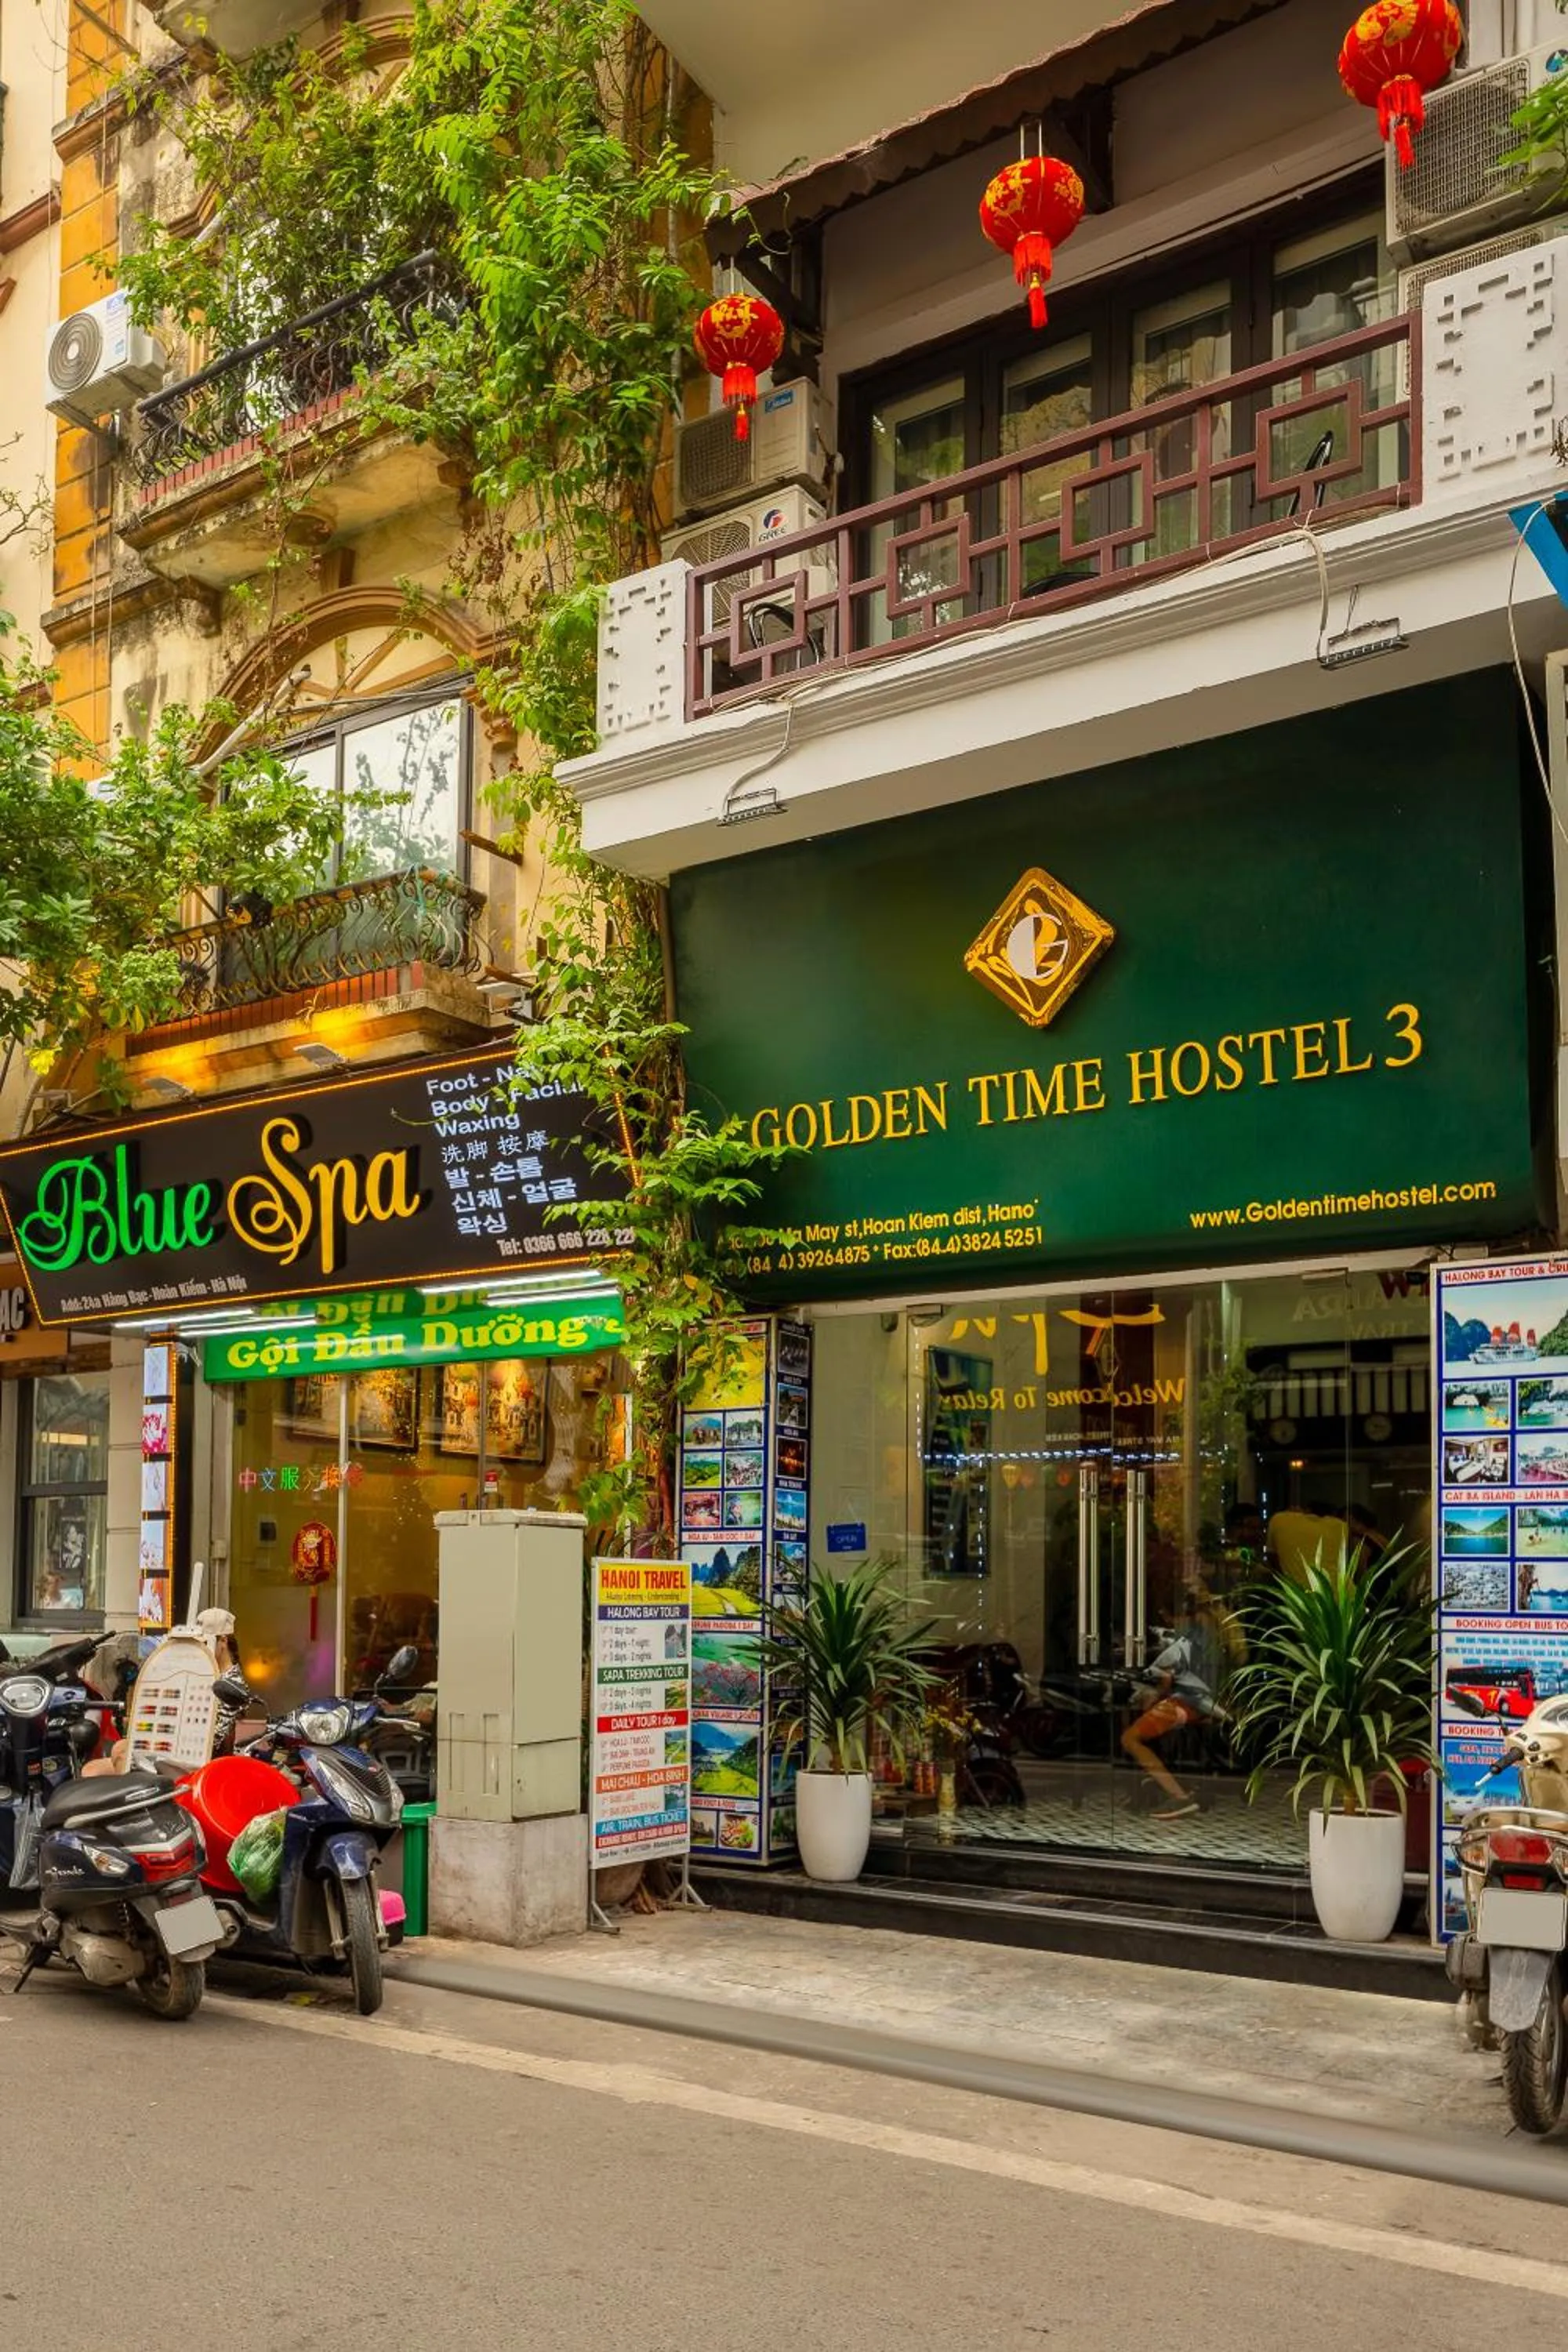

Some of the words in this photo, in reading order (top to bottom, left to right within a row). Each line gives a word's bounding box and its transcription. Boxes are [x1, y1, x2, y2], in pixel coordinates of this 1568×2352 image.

[426, 1073, 479, 1095] Foot
[750, 1081, 949, 1150] GOLDEN
[968, 1058, 1105, 1126] TIME
[1126, 1017, 1374, 1105] HOSTEL
[1385, 1003, 1423, 1068] 3
[431, 1098, 489, 1117] Body
[434, 1112, 521, 1138] Waxing
[445, 1166, 470, 1189] 발
[16, 1144, 215, 1271] Blue
[227, 1117, 420, 1274] Spa
[451, 1188, 503, 1214] 신체
[521, 1177, 577, 1204] 얼굴
[1189, 1181, 1497, 1229] www.Goldentimehostel.com
[806, 1224, 840, 1243] May
[909, 1210, 949, 1231] Kiem
[496, 1239, 523, 1256] Tel:
[557, 1230, 583, 1250] 666
[1445, 1271, 1486, 1282] HALONG
[1487, 1269, 1506, 1279] BAY
[1509, 1266, 1535, 1277] TOUR
[227, 1330, 300, 1372] Gội
[314, 1320, 405, 1362] Đầu
[420, 1313, 588, 1352] Dưỡng
[601, 1569, 641, 1588] HANOI
[644, 1570, 686, 1589] TRAVEL
[608, 1606, 641, 1619] HALONG
[643, 1607, 659, 1617] BAY
[660, 1606, 681, 1617] TOUR
[1456, 1619, 1502, 1628] BOOKING
[1504, 1620, 1531, 1629] OPEN
[1535, 1621, 1553, 1629] BUS
[603, 1668, 625, 1682] SAPA
[664, 1666, 684, 1678] TOUR
[612, 1716, 636, 1730] DAILY
[637, 1715, 658, 1729] TOUR
[1448, 1726, 1494, 1736] BOOKING
[648, 1772, 666, 1784] HOA
